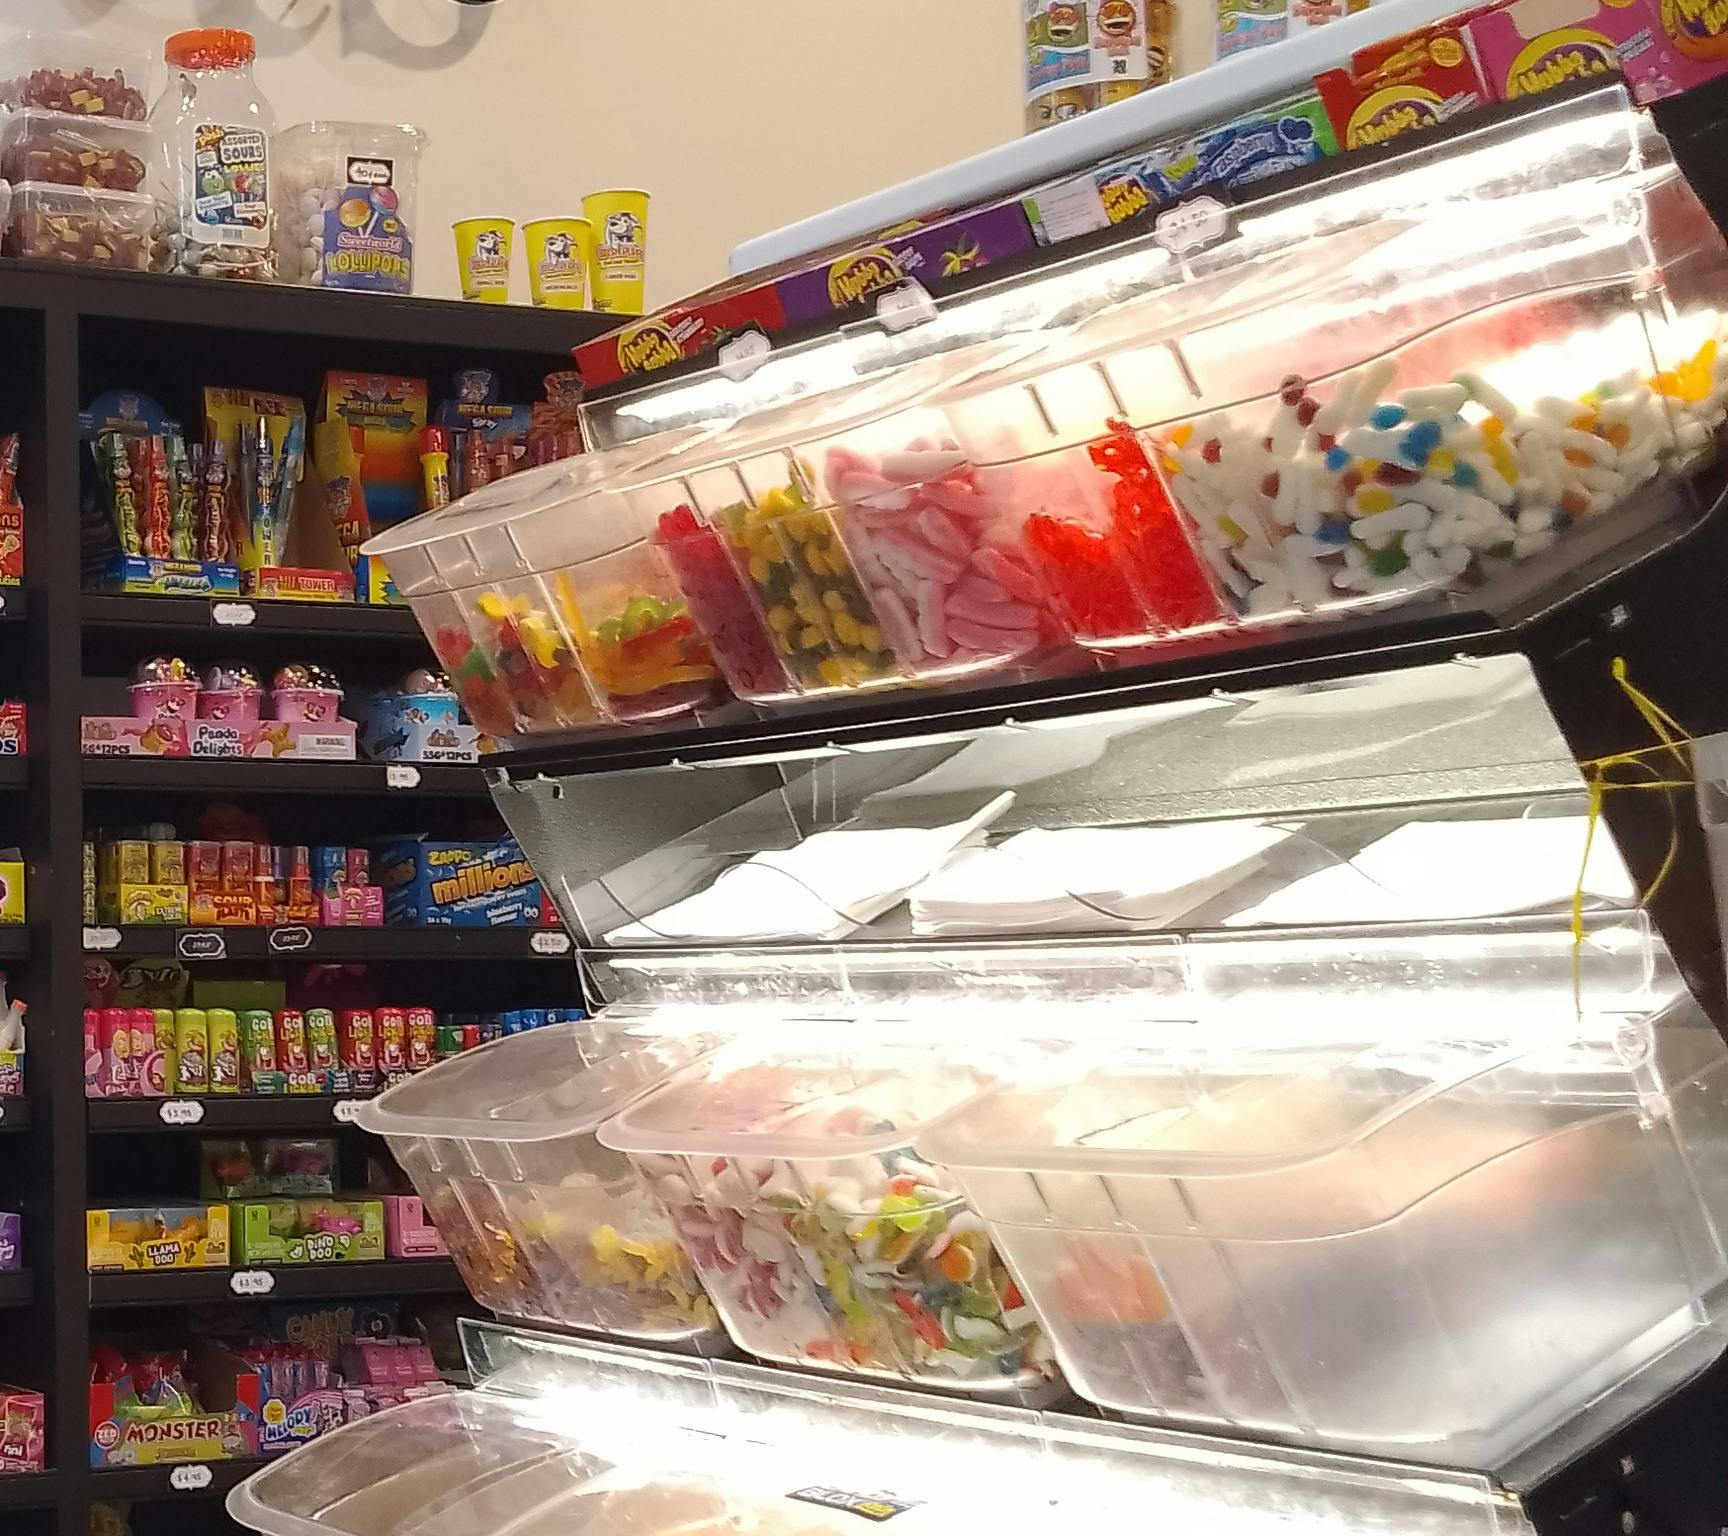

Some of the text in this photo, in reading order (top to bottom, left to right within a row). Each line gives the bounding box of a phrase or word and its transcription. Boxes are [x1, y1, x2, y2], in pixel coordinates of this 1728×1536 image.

[222, 135, 261, 146] ASSORTED
[223, 146, 263, 161] SOURS
[339, 232, 402, 251] Sweetworld
[327, 252, 410, 277] LOLLIPOPS
[300, 578, 335, 592] TOWER
[198, 726, 238, 741] Panda
[192, 740, 244, 756] Delights
[428, 850, 471, 864] ZAPPO
[432, 859, 536, 906] millions
[213, 895, 253, 908] SOUR
[485, 901, 522, 917] blueberry
[148, 1243, 180, 1256] LLAMA
[307, 1236, 334, 1251] DINO
[154, 1253, 174, 1264] DOO
[309, 1247, 332, 1260] DOO
[126, 1419, 220, 1443] MONSTER
[266, 1407, 313, 1440] MELODY
[97, 1428, 117, 1439] ZED
